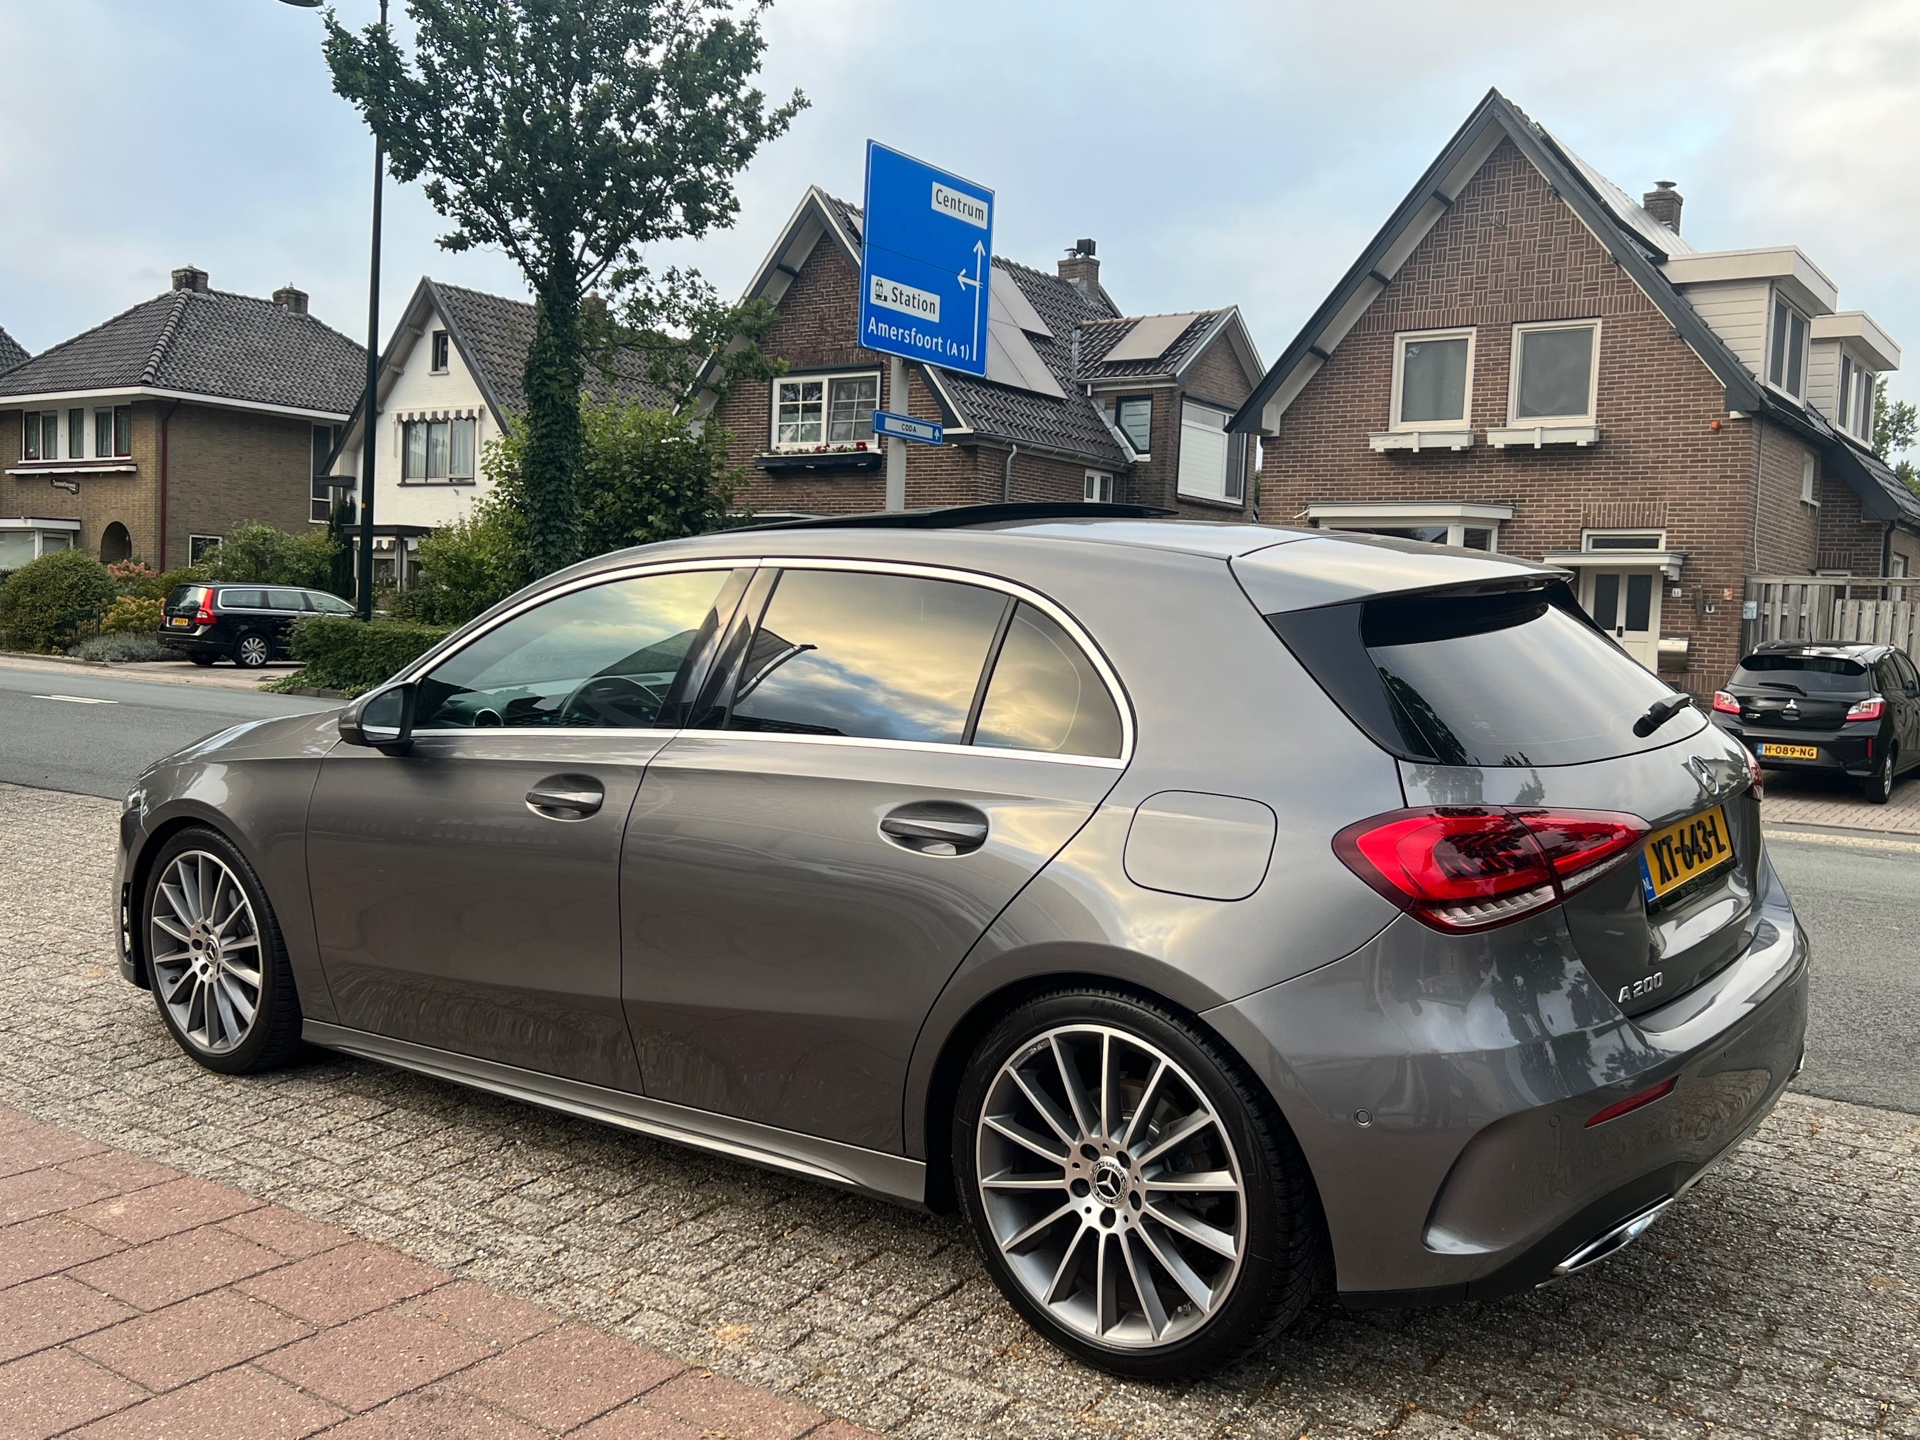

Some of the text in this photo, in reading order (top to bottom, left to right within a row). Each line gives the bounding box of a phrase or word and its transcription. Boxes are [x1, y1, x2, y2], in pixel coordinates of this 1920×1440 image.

[935, 188, 984, 221] Centrum
[891, 286, 937, 315] Station
[868, 316, 943, 353] Amersfoort
[901, 423, 917, 433] CODA
[1764, 745, 1814, 757] H-089-NG
[1651, 814, 1726, 886] XT-643-L
[1642, 877, 1653, 892] NL
[1617, 971, 1664, 1003] A 200
